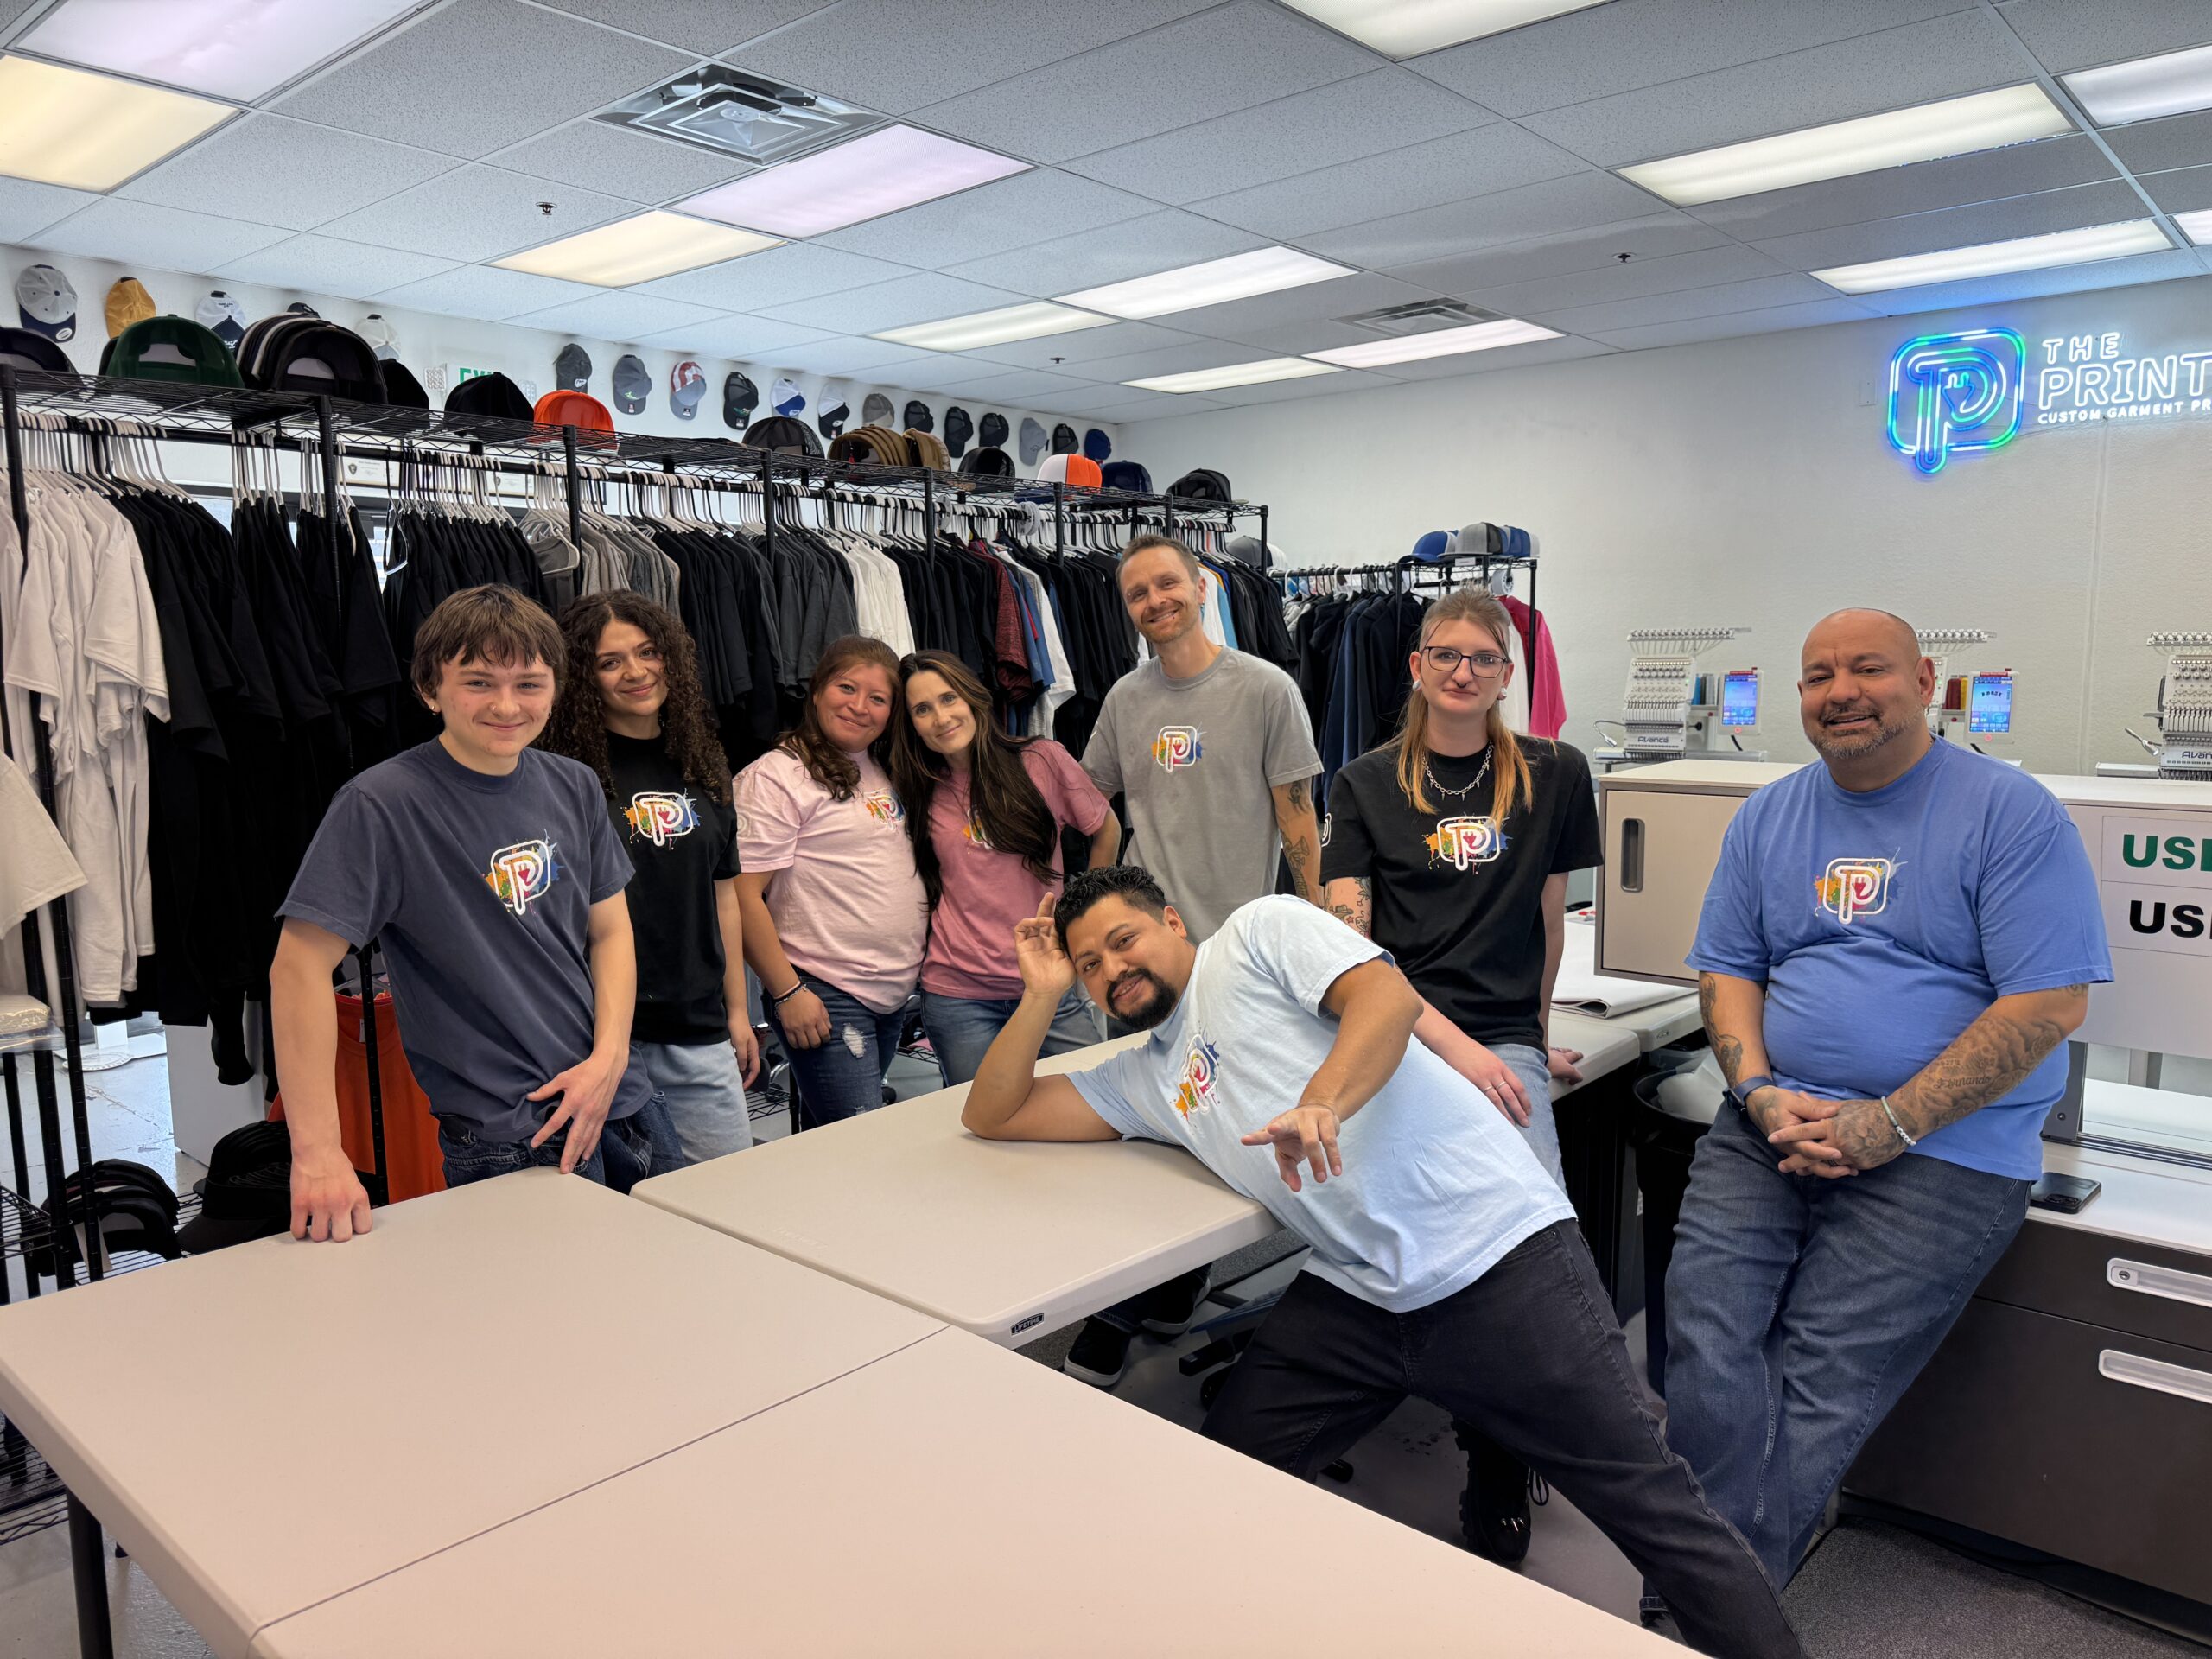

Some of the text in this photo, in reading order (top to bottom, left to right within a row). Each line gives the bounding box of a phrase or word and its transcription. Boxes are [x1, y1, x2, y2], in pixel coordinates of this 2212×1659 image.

[2042, 332, 2121, 365] THE
[2037, 350, 2212, 410] PRINT
[2037, 409, 2101, 425] CUSTOM
[2107, 400, 2185, 419] GARMENT
[1014, 1316, 1041, 1332] LIFETIME
